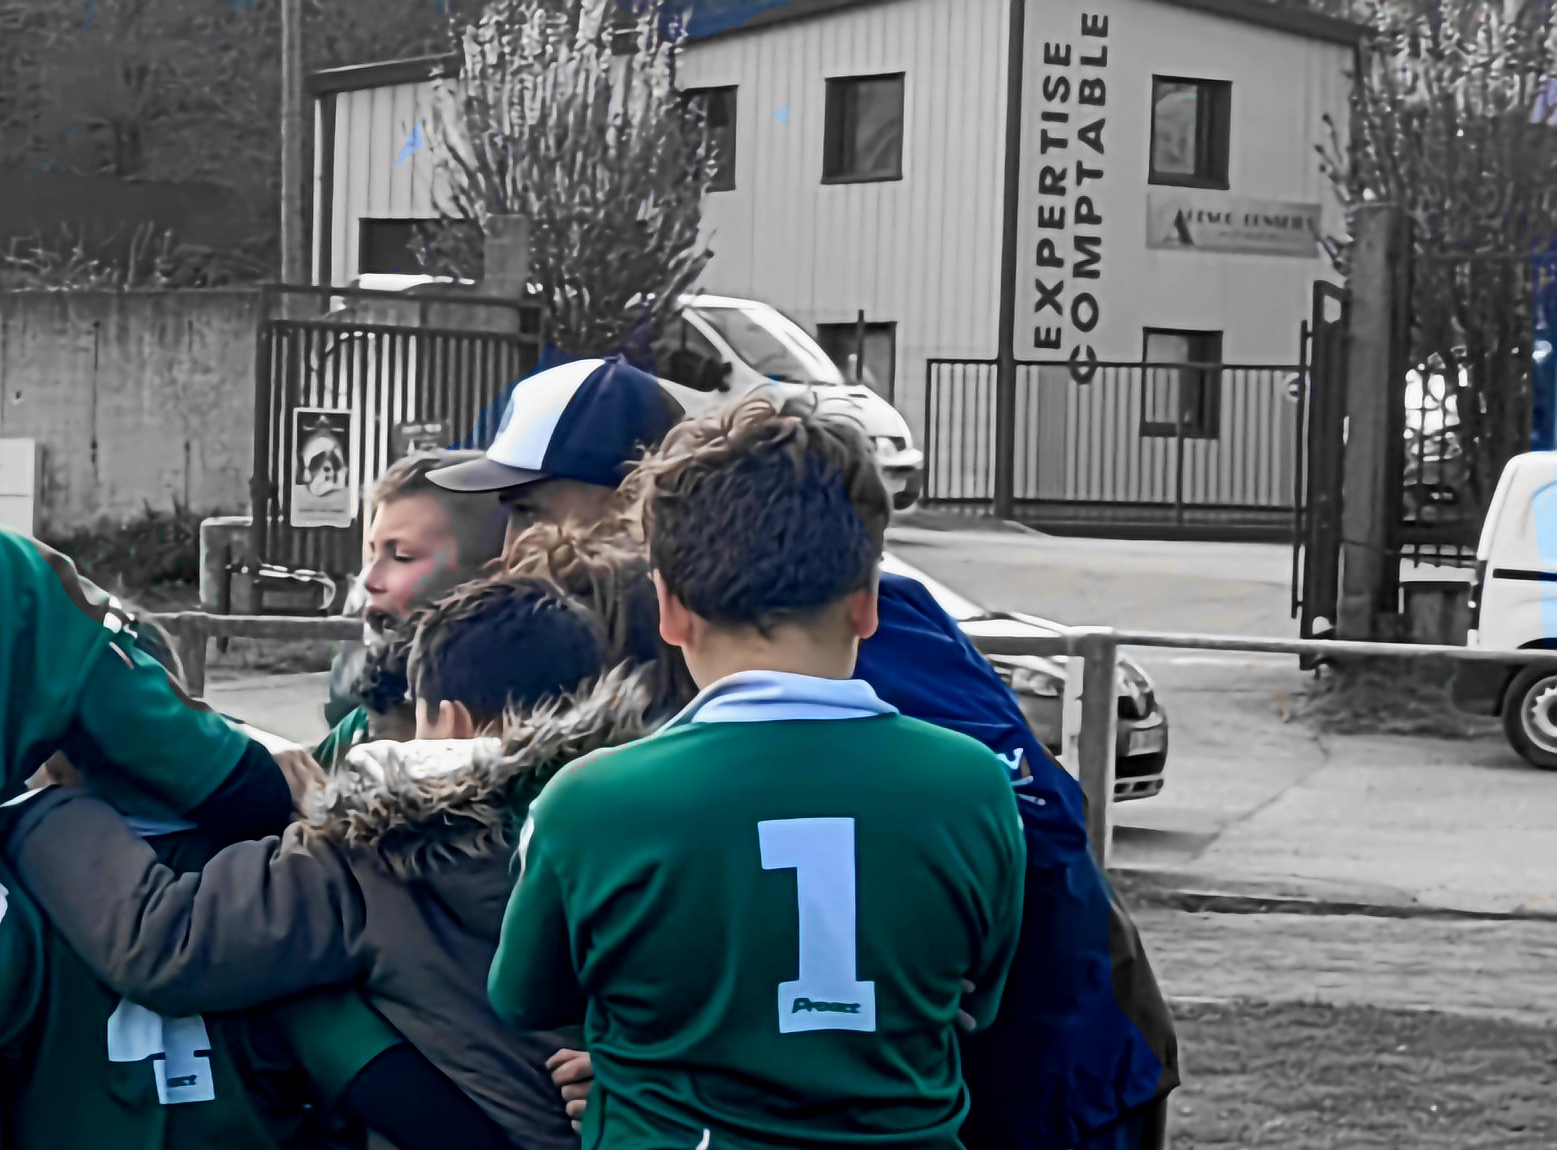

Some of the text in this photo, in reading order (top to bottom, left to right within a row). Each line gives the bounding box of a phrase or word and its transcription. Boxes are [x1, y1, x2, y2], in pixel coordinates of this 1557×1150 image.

[1034, 42, 1071, 350] EXPERTISE
[1069, 13, 1109, 385] COMPTABLE
[757, 816, 877, 1034] 1
